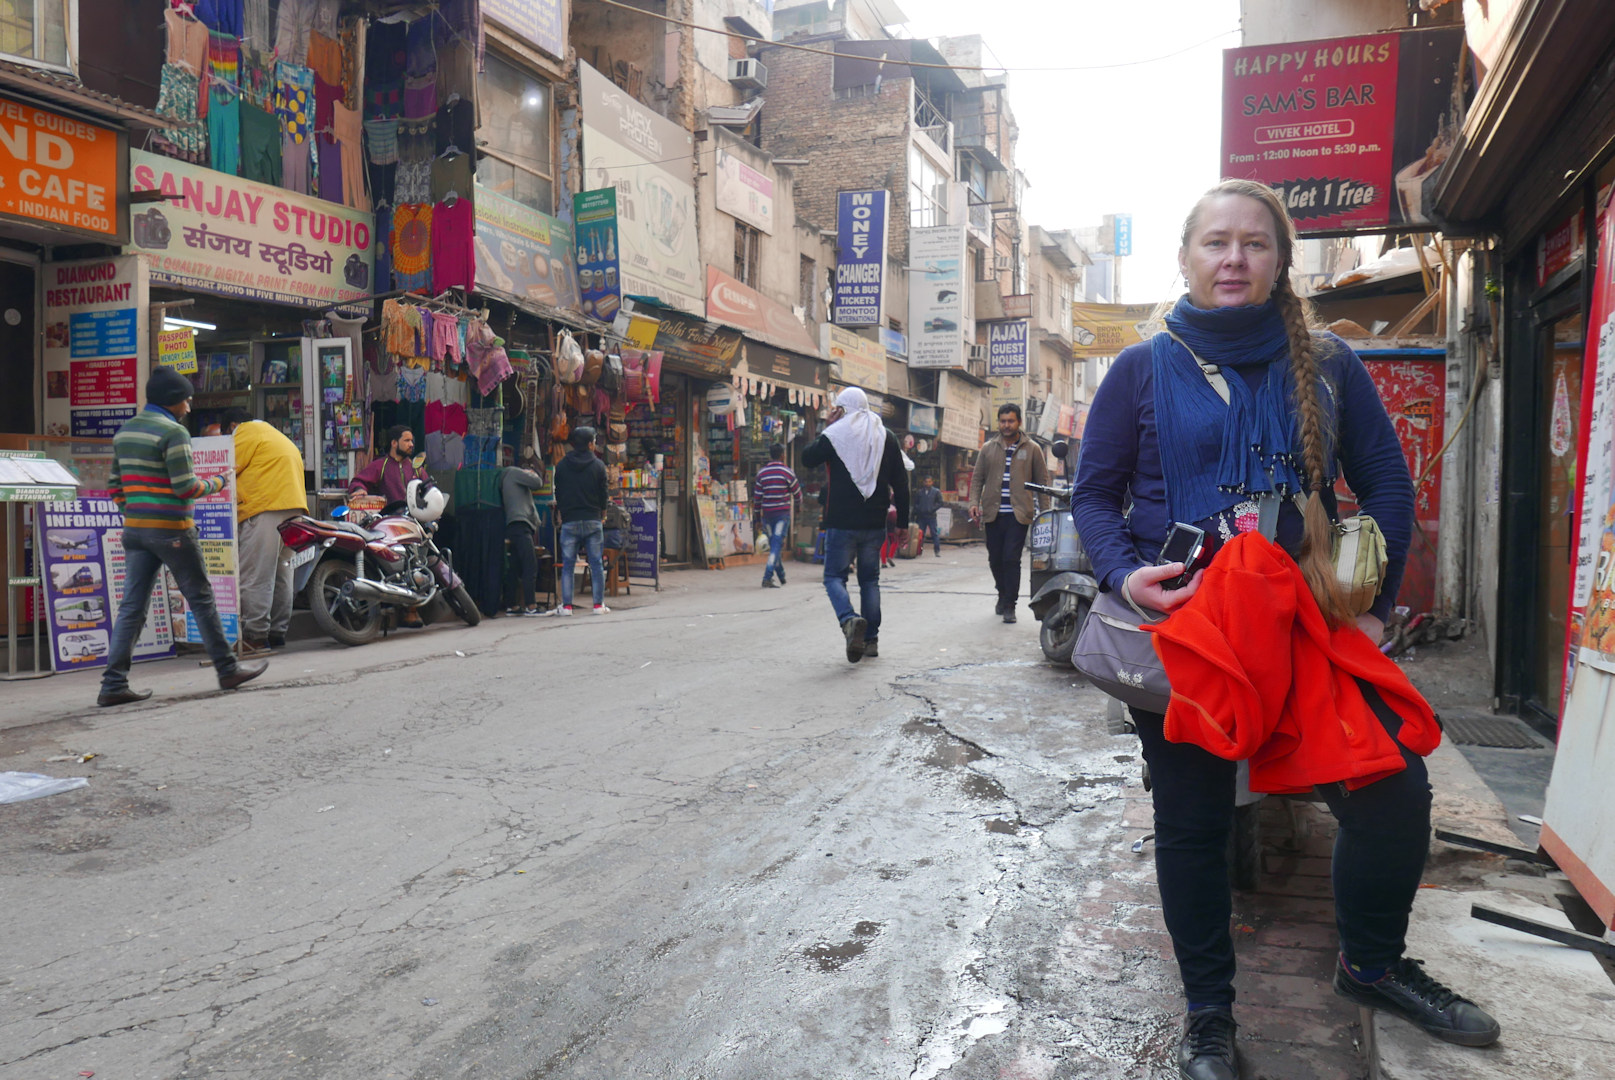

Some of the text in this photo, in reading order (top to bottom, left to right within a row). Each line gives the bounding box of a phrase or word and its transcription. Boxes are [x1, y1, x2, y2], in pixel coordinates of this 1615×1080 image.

[1233, 42, 1391, 77] HAPPY HOURS
[1302, 73, 1315, 83] AT
[1242, 84, 1376, 116] SAM'S BAR
[33, 112, 97, 142] GUIDES
[1267, 123, 1340, 139] VIVEK HOTEL
[1229, 153, 1255, 163] From
[1263, 149, 1290, 161] 12:00
[1292, 148, 1319, 158] Noon
[1321, 146, 1332, 156] to
[1334, 144, 1356, 154] 5:30
[1358, 143, 1381, 155] p.m.
[19, 168, 106, 212] CAFE
[1288, 184, 1317, 209] Get
[1324, 183, 1332, 206] 1
[1337, 181, 1374, 206] Free
[19, 199, 110, 231] INDIAN FOOD
[134, 165, 370, 251] SANJAY STUDIO
[851, 193, 873, 259] MONEY
[1119, 217, 1129, 255] ARJUN
[183, 223, 334, 275] संजय स्टूडियो
[57, 262, 117, 285] DIAMOND
[163, 256, 212, 279] QUALITY
[214, 265, 255, 287] DIGITAL
[257, 274, 288, 292] PRINT
[290, 280, 316, 296] FROM
[317, 286, 336, 300] ANY
[837, 263, 880, 284] CHANGER
[46, 282, 132, 307] RESTAURANT
[170, 273, 215, 290] PASSPORT
[216, 282, 244, 296] PHOTO
[246, 288, 255, 296] IN
[256, 289, 274, 300] FIVE
[837, 285, 879, 295] AIR & BUS
[840, 296, 876, 305] TICKETS
[159, 330, 192, 342] PASSPORT
[659, 320, 687, 337] Delhi
[991, 324, 1026, 342] AJAY
[165, 341, 188, 351] PHOTO
[992, 343, 1024, 354] GUEST
[176, 361, 195, 371] DRIVE
[992, 355, 1025, 366] HOUSE
[44, 500, 83, 513] FREE
